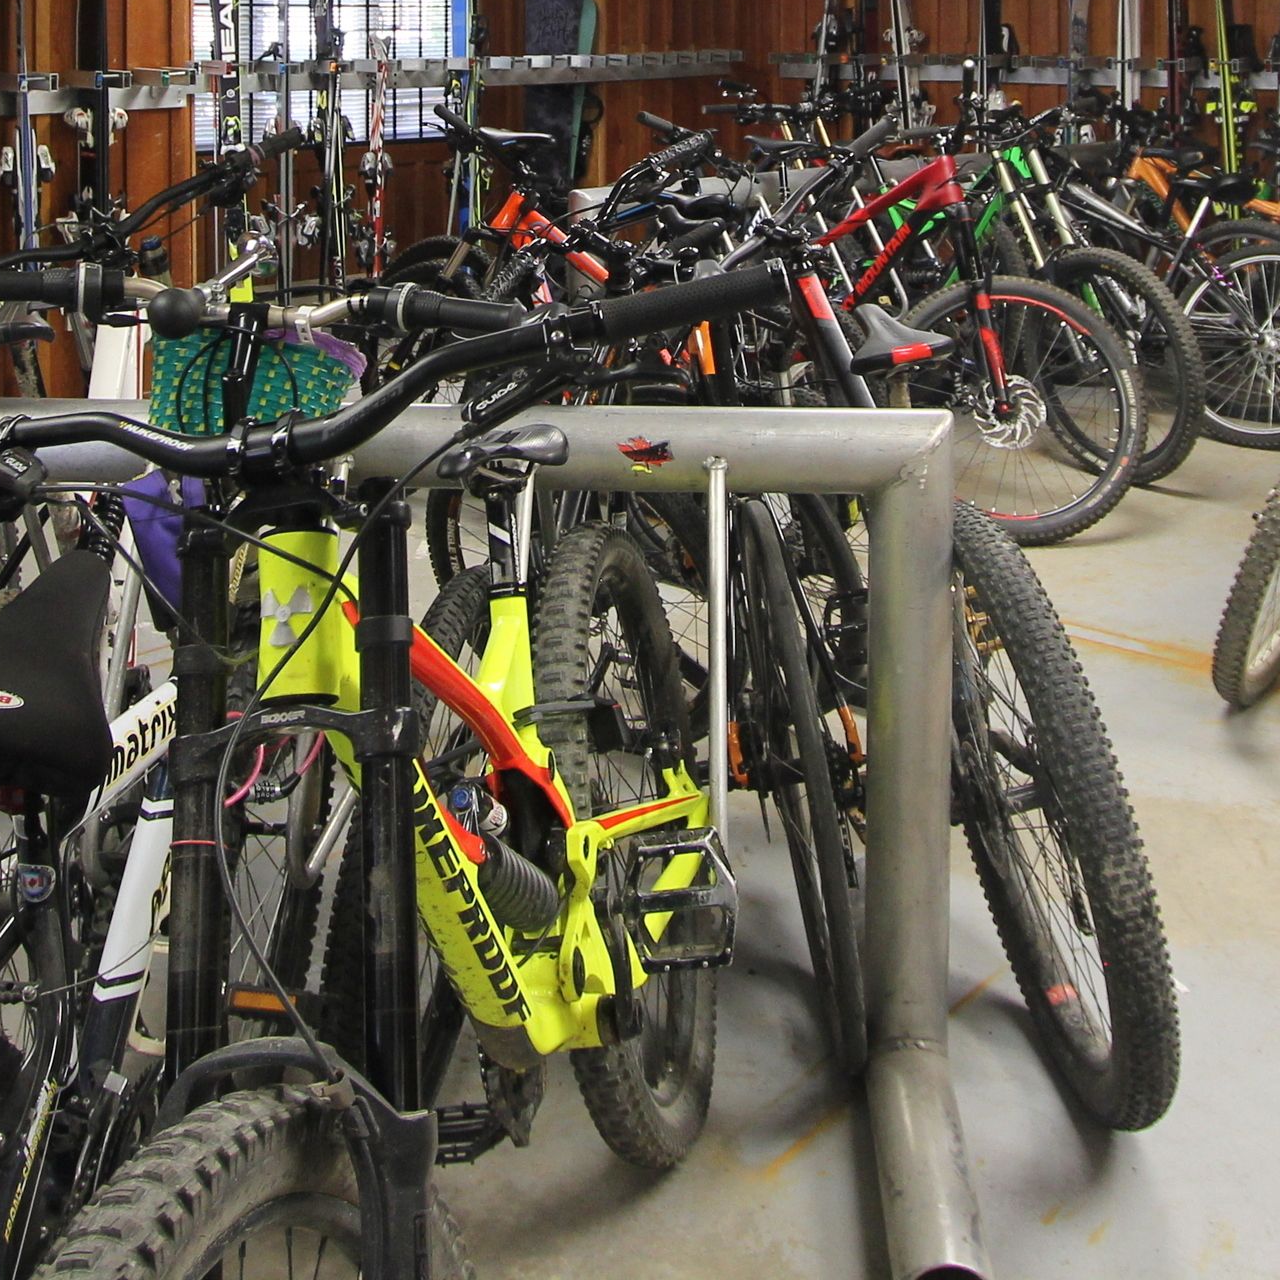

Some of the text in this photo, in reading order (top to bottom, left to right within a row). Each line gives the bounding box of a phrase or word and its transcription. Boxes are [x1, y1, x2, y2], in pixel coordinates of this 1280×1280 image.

[854, 222, 913, 297] MOUNTAIN
[475, 381, 519, 412] GUIDE
[121, 422, 196, 451] NUKEPROOF
[261, 709, 306, 724] BOXXER
[414, 765, 533, 1022] KEPROOF
